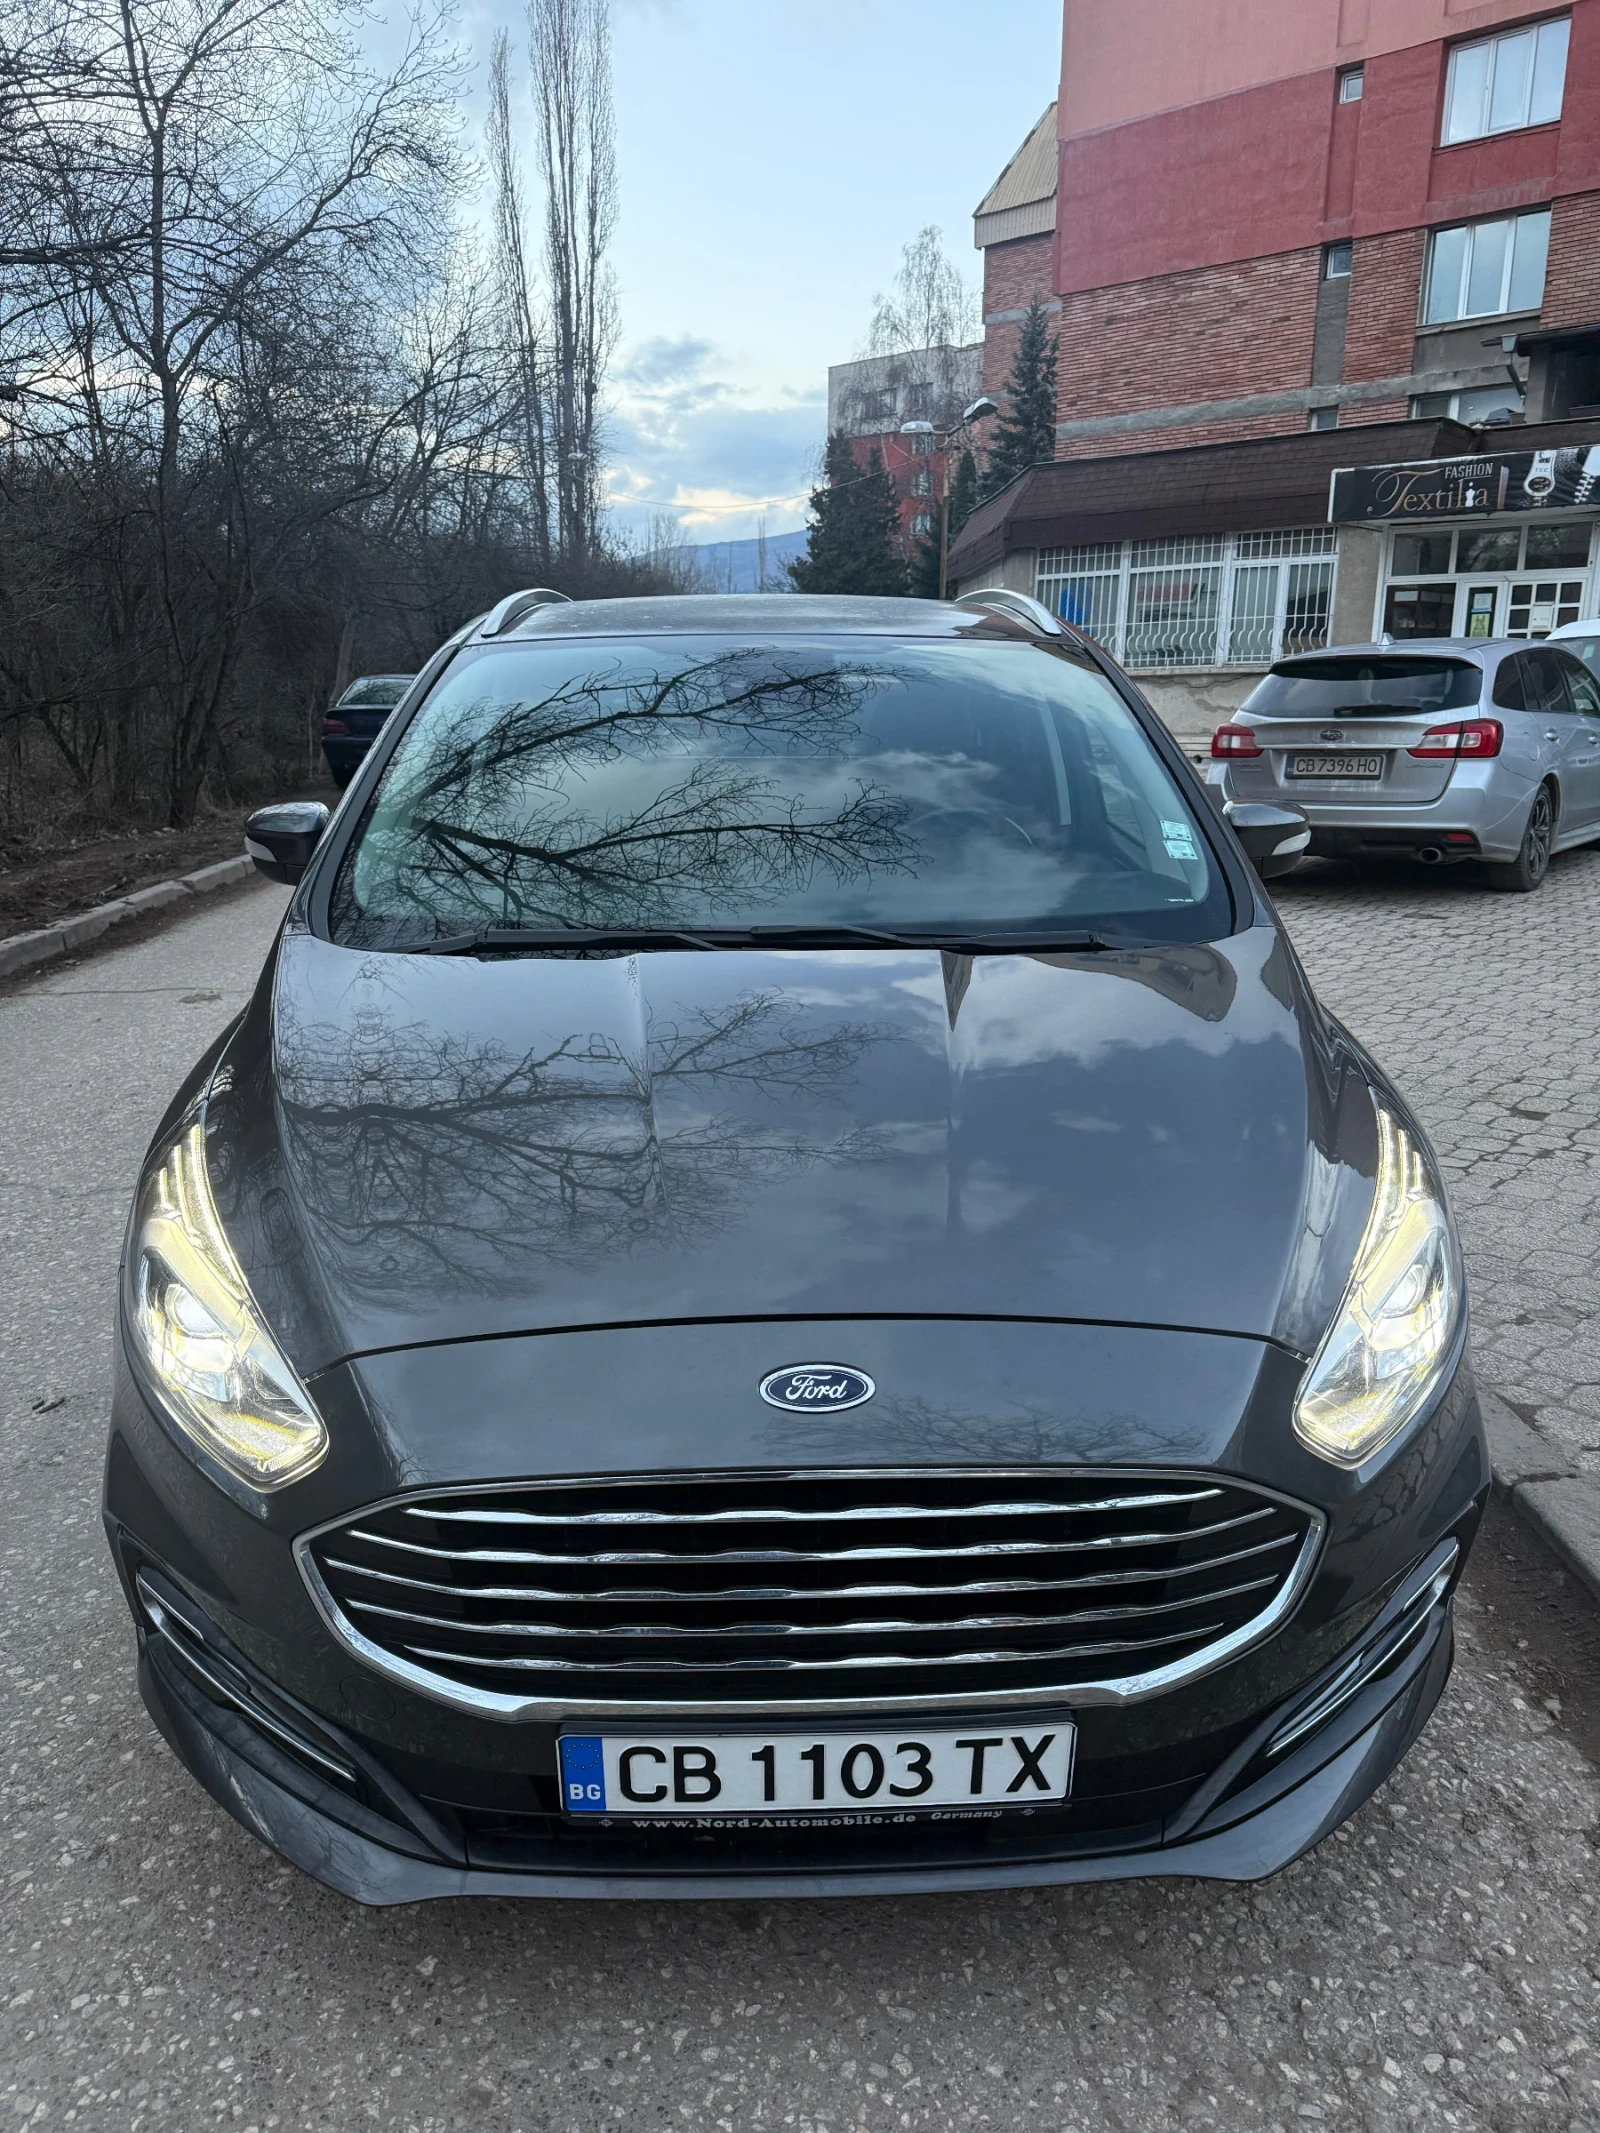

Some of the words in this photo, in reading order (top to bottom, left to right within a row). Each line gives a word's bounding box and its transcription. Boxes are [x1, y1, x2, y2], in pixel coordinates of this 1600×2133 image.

[1444, 462, 1494, 479] FASHION
[1367, 467, 1490, 518] Textilia
[1296, 758, 1315, 773] CB
[1318, 758, 1354, 773] 7396
[1356, 758, 1378, 773] HO
[785, 1374, 848, 1400] Ford
[618, 1745, 722, 1803] CB
[751, 1741, 933, 1803] 1103
[955, 1733, 1057, 1796] TX
[569, 1783, 601, 1800] BG
[632, 1812, 917, 1829] www.Nord-Automobile.de
[930, 1809, 1003, 1821] Germany
